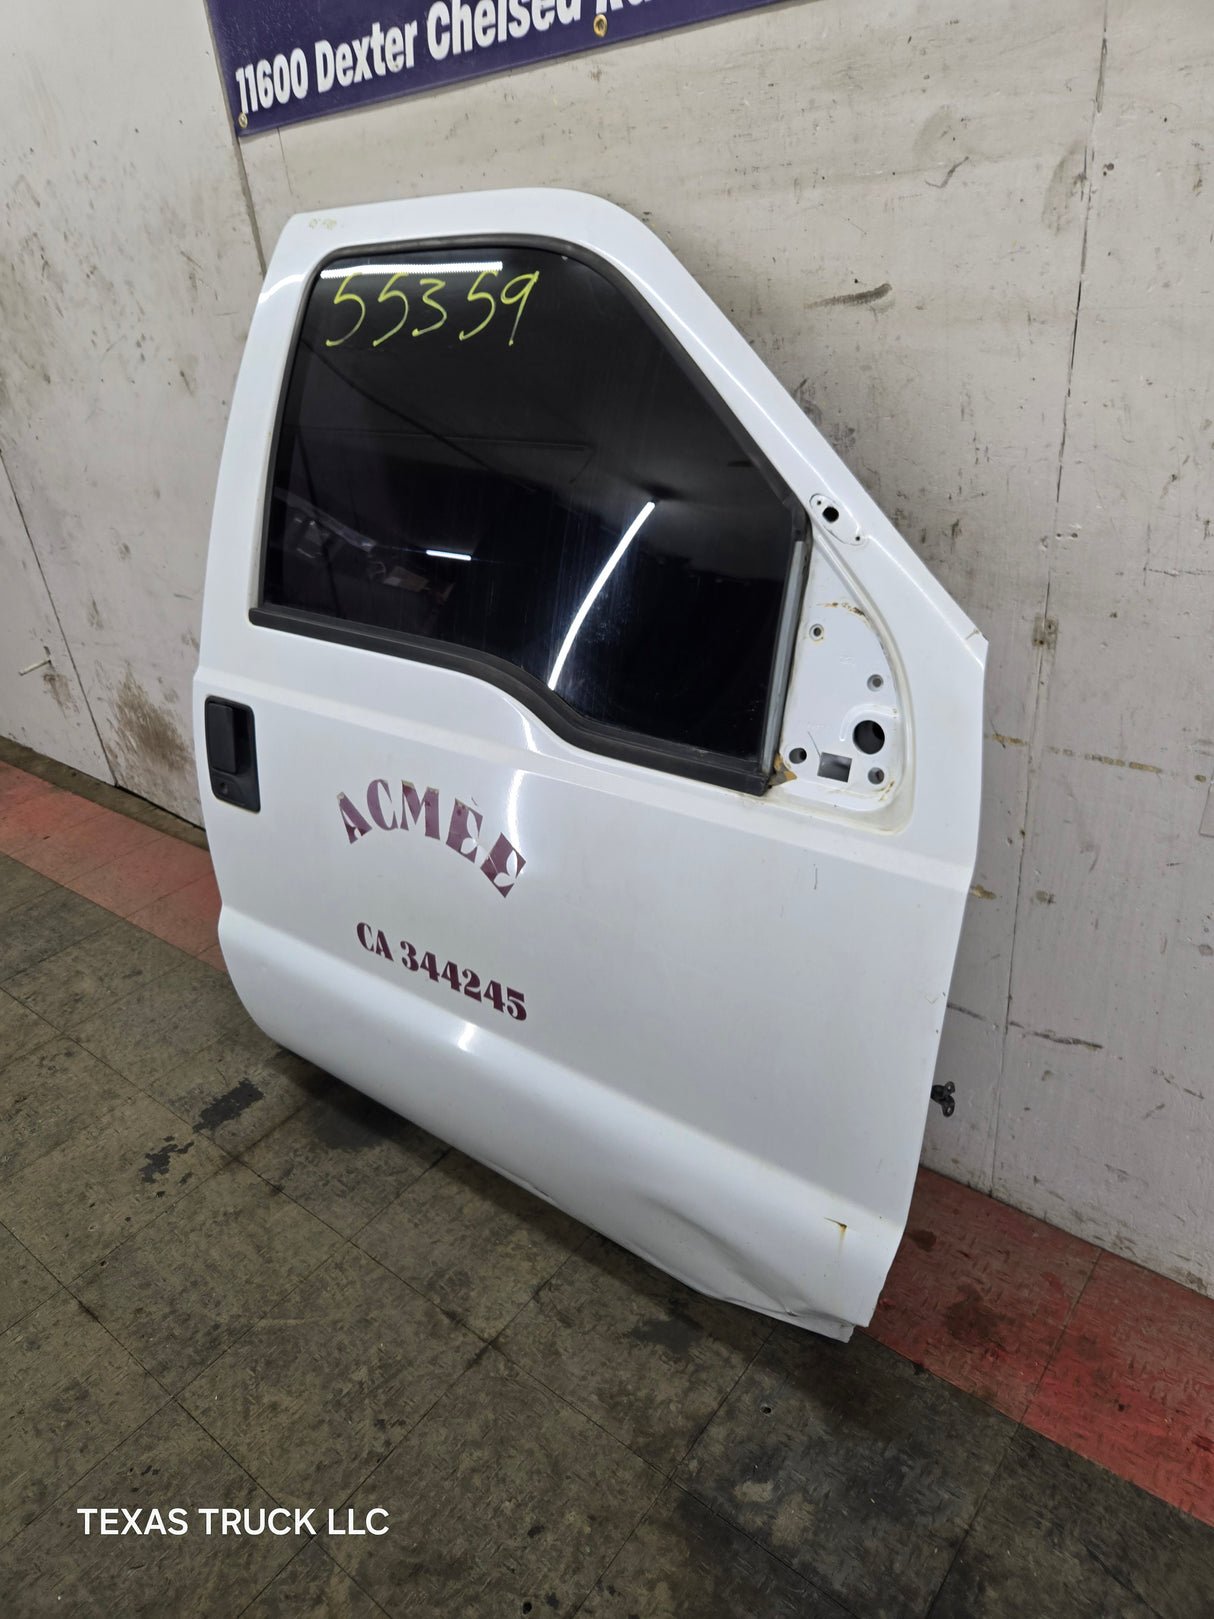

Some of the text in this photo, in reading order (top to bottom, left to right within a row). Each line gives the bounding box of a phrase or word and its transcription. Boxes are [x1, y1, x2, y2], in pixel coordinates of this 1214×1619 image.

[235, 48, 309, 114] 11600
[314, 20, 418, 94] Dexter
[325, 270, 540, 347] 55359
[337, 779, 527, 898] ACMEE
[356, 922, 528, 1022] CA 344245
